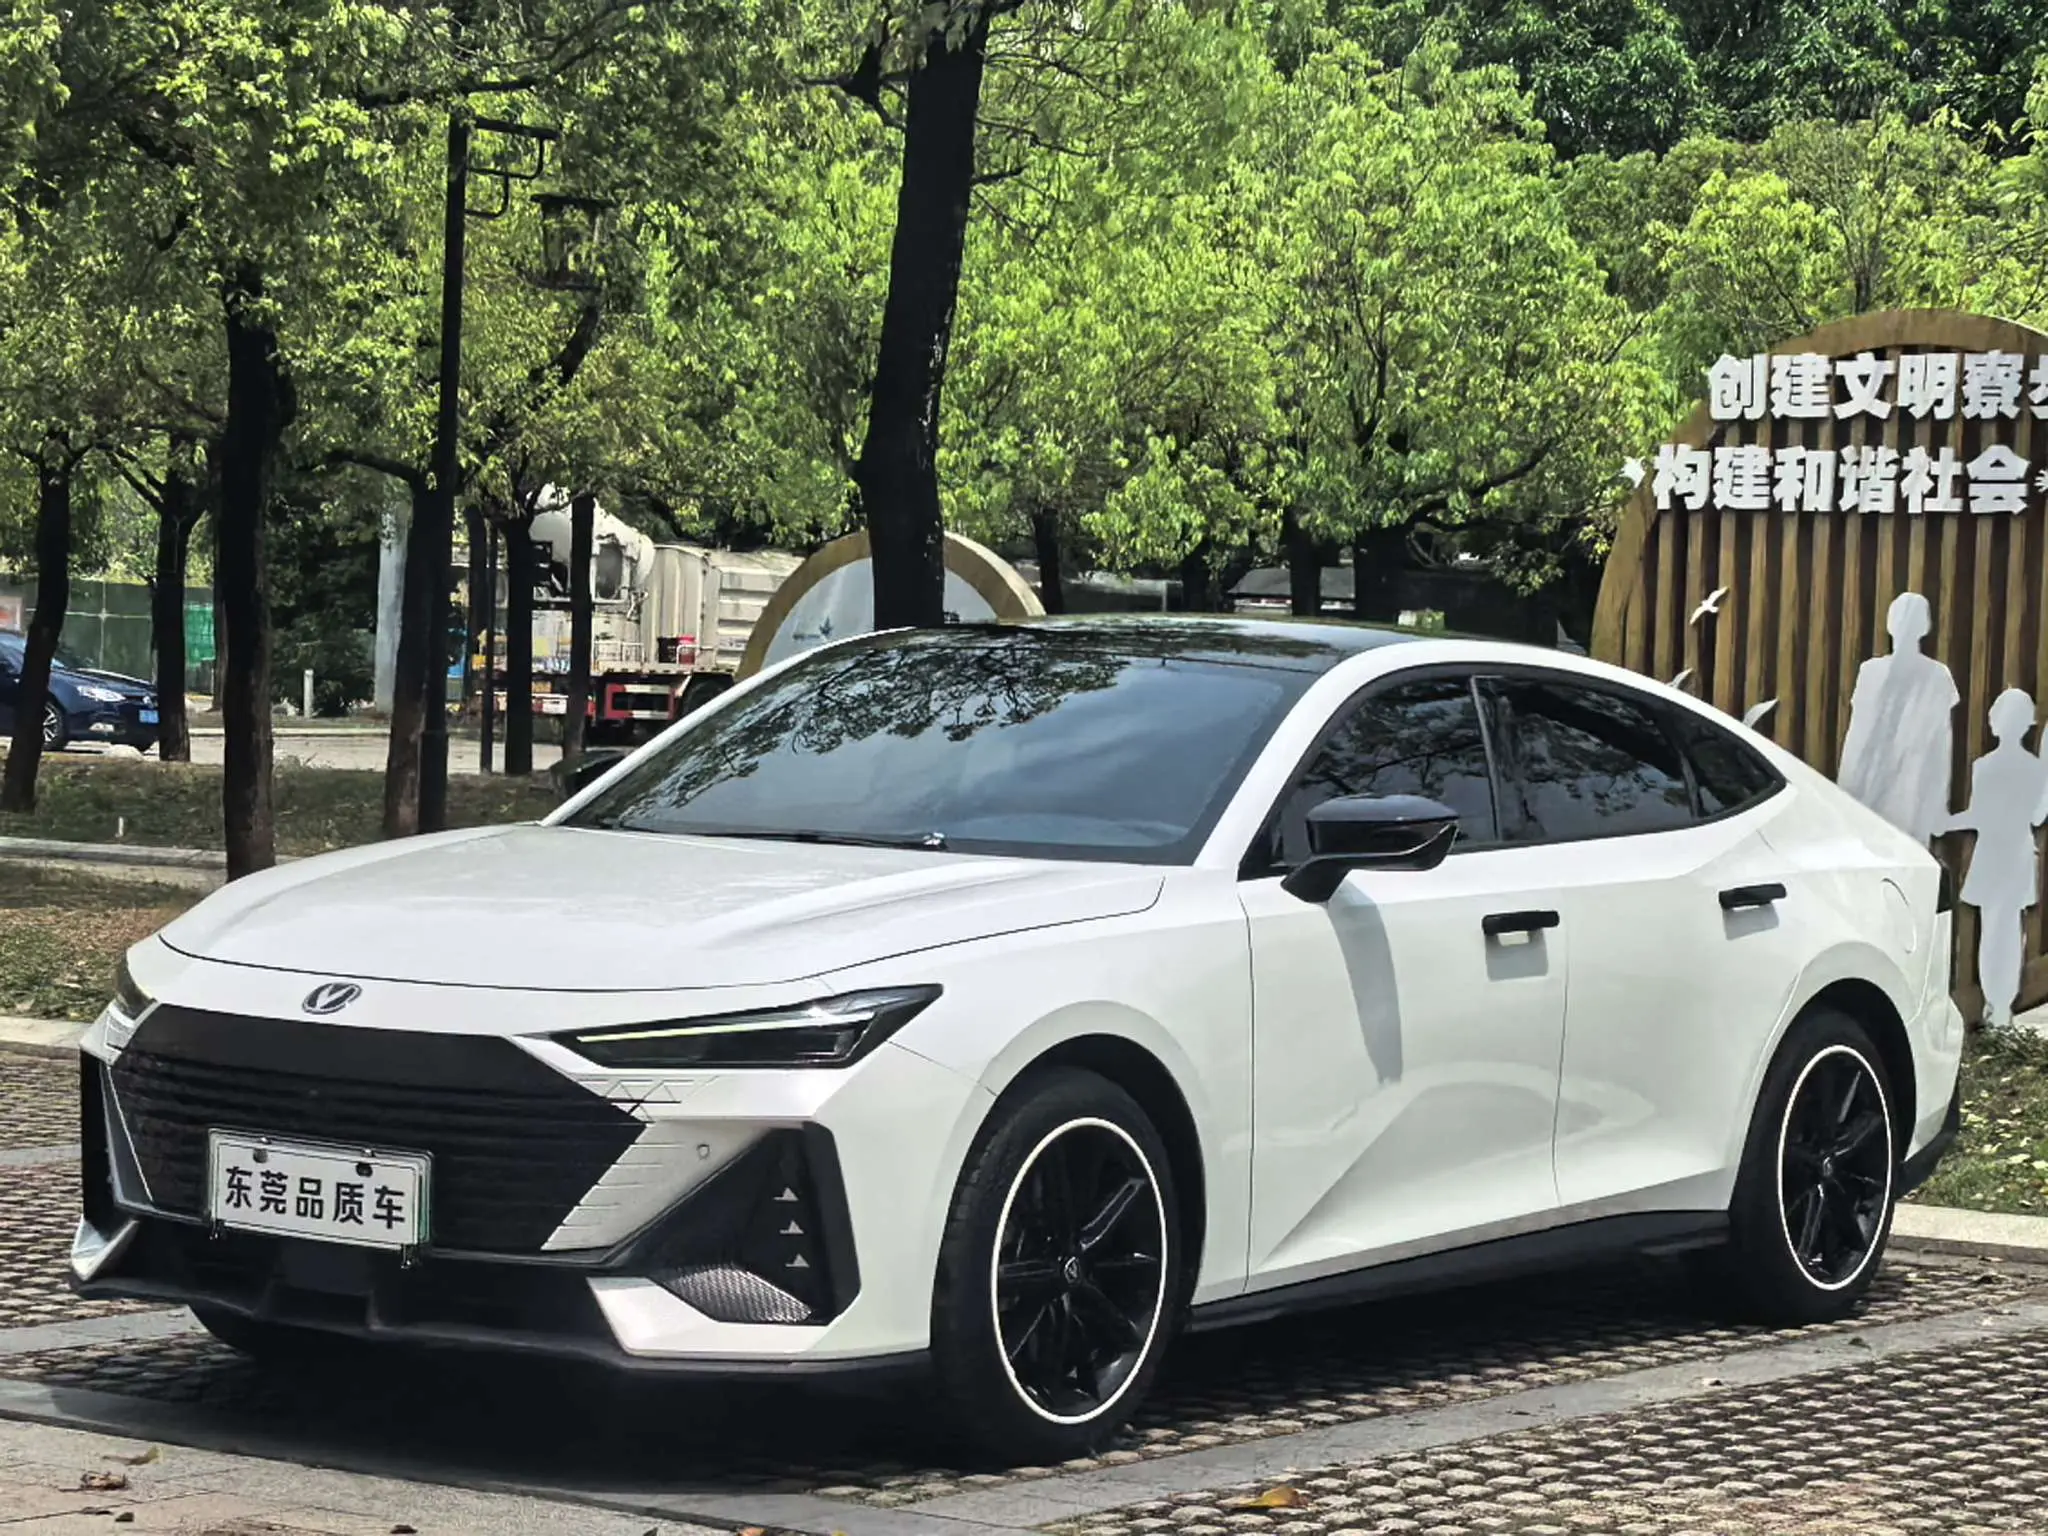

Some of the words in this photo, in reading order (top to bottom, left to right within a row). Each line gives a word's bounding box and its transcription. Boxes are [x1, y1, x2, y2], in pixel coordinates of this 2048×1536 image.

[1652, 443, 2030, 514] 构建和谐社会
[225, 1166, 405, 1229] 东莞品质车
